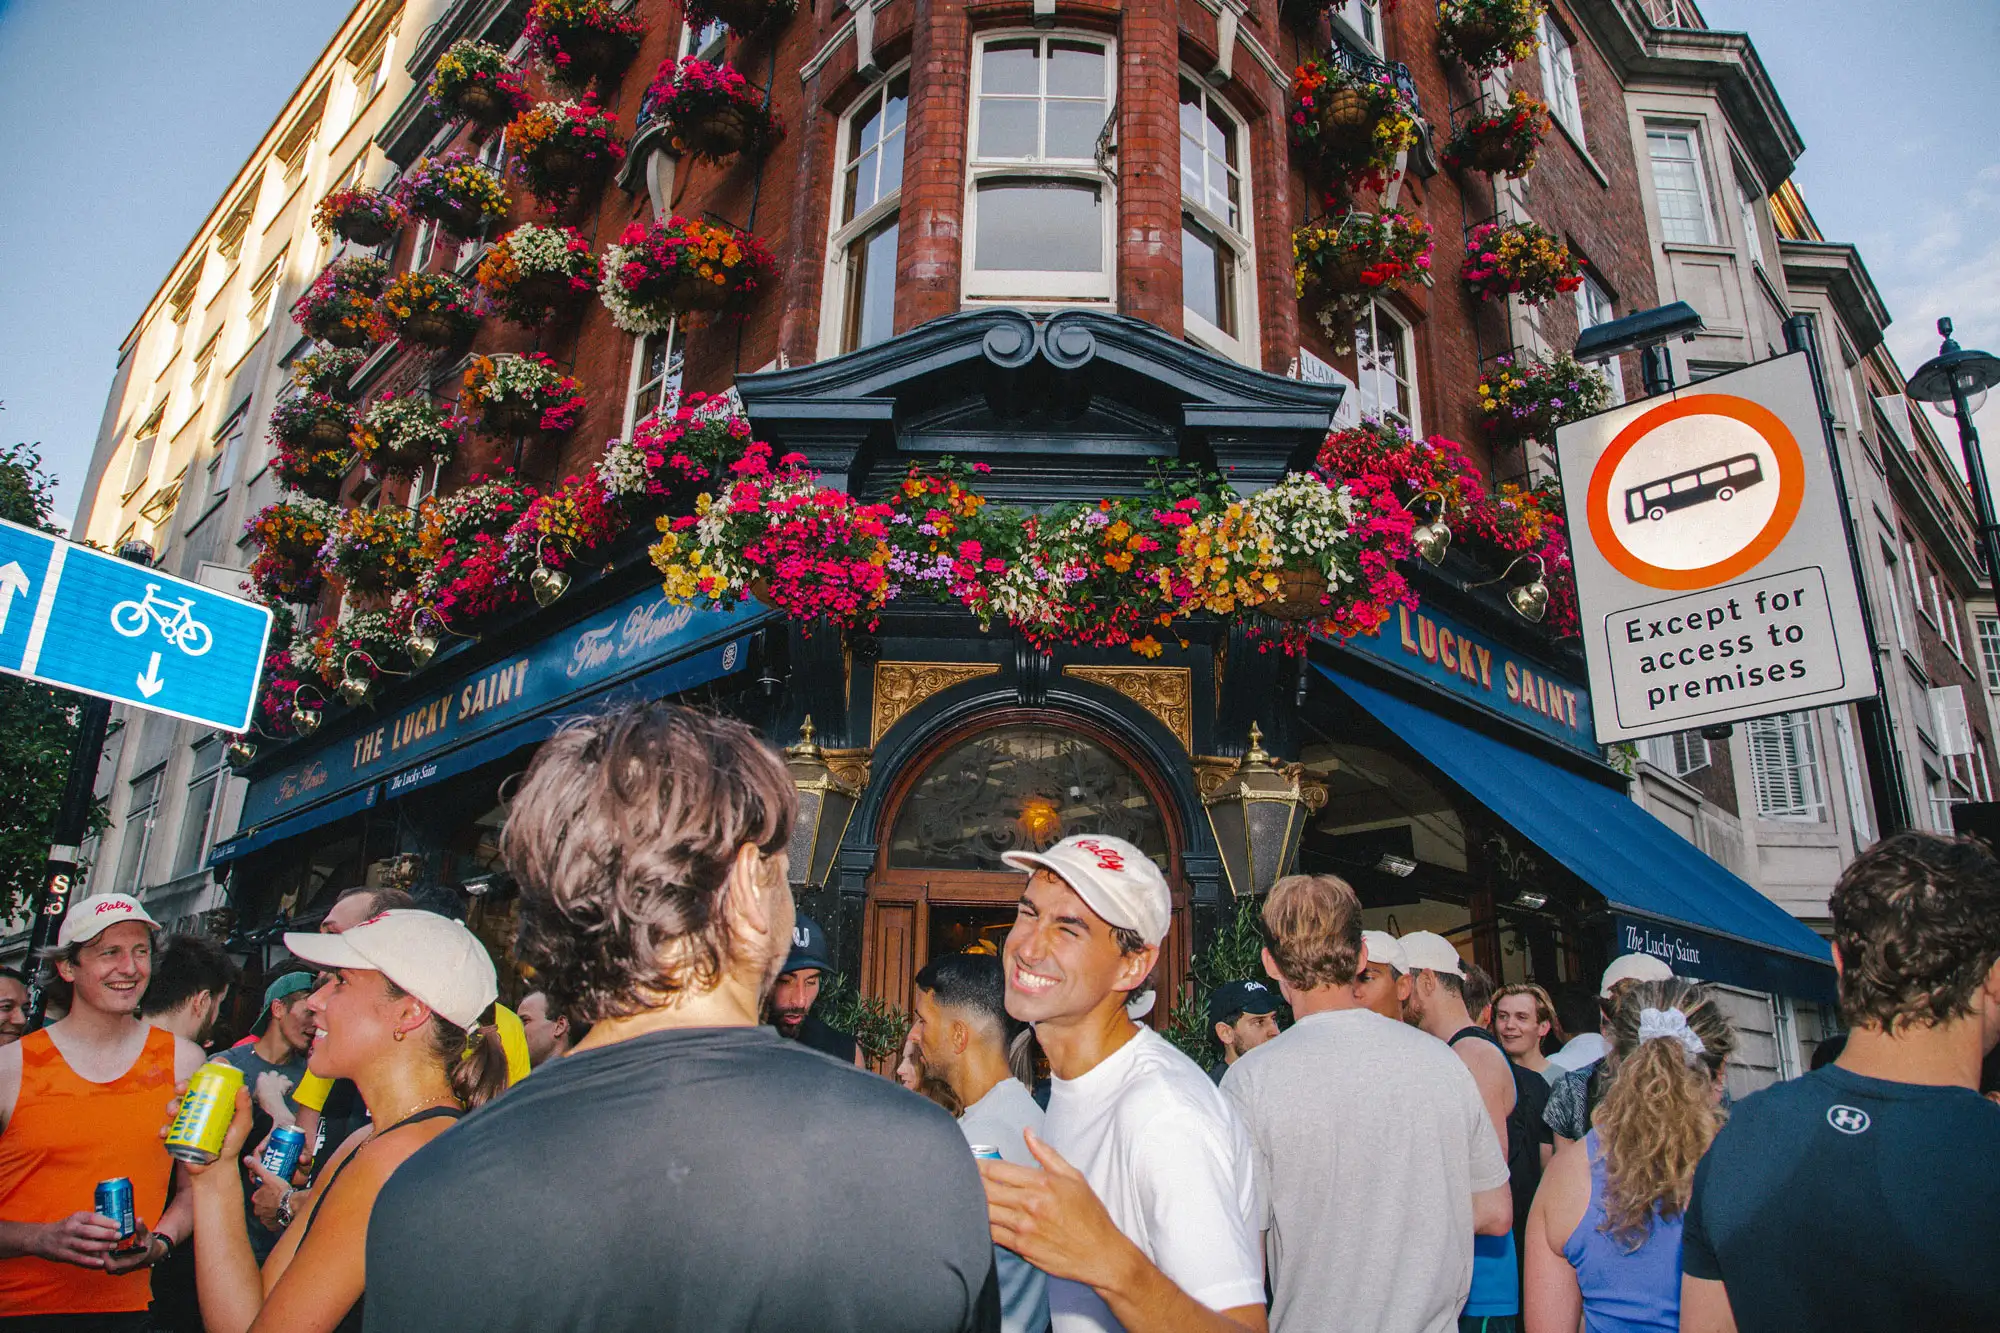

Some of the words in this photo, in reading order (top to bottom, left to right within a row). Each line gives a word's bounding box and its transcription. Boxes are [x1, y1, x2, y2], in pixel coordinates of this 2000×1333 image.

[567, 619, 617, 678] Free
[618, 597, 692, 659] House
[1625, 598, 1742, 643] Except
[1755, 588, 1804, 614] for
[1399, 603, 1493, 692] LUCKY
[1504, 660, 1577, 729] SAINT
[1639, 635, 1753, 673] access
[1768, 624, 1804, 646] to
[1647, 659, 1806, 710] premises
[352, 727, 385, 770] THE
[391, 693, 454, 751] LUCKY
[458, 658, 529, 721] SAINT
[95, 901, 133, 915] Rally
[1626, 925, 1644, 951] The
[1645, 930, 1675, 966] Lucky
[1675, 937, 1701, 965] Saint
[170, 1089, 198, 1141] LUCKY
[183, 1090, 217, 1143] SAINT
[262, 1146, 275, 1169] CKY
[267, 1149, 286, 1174] INT
